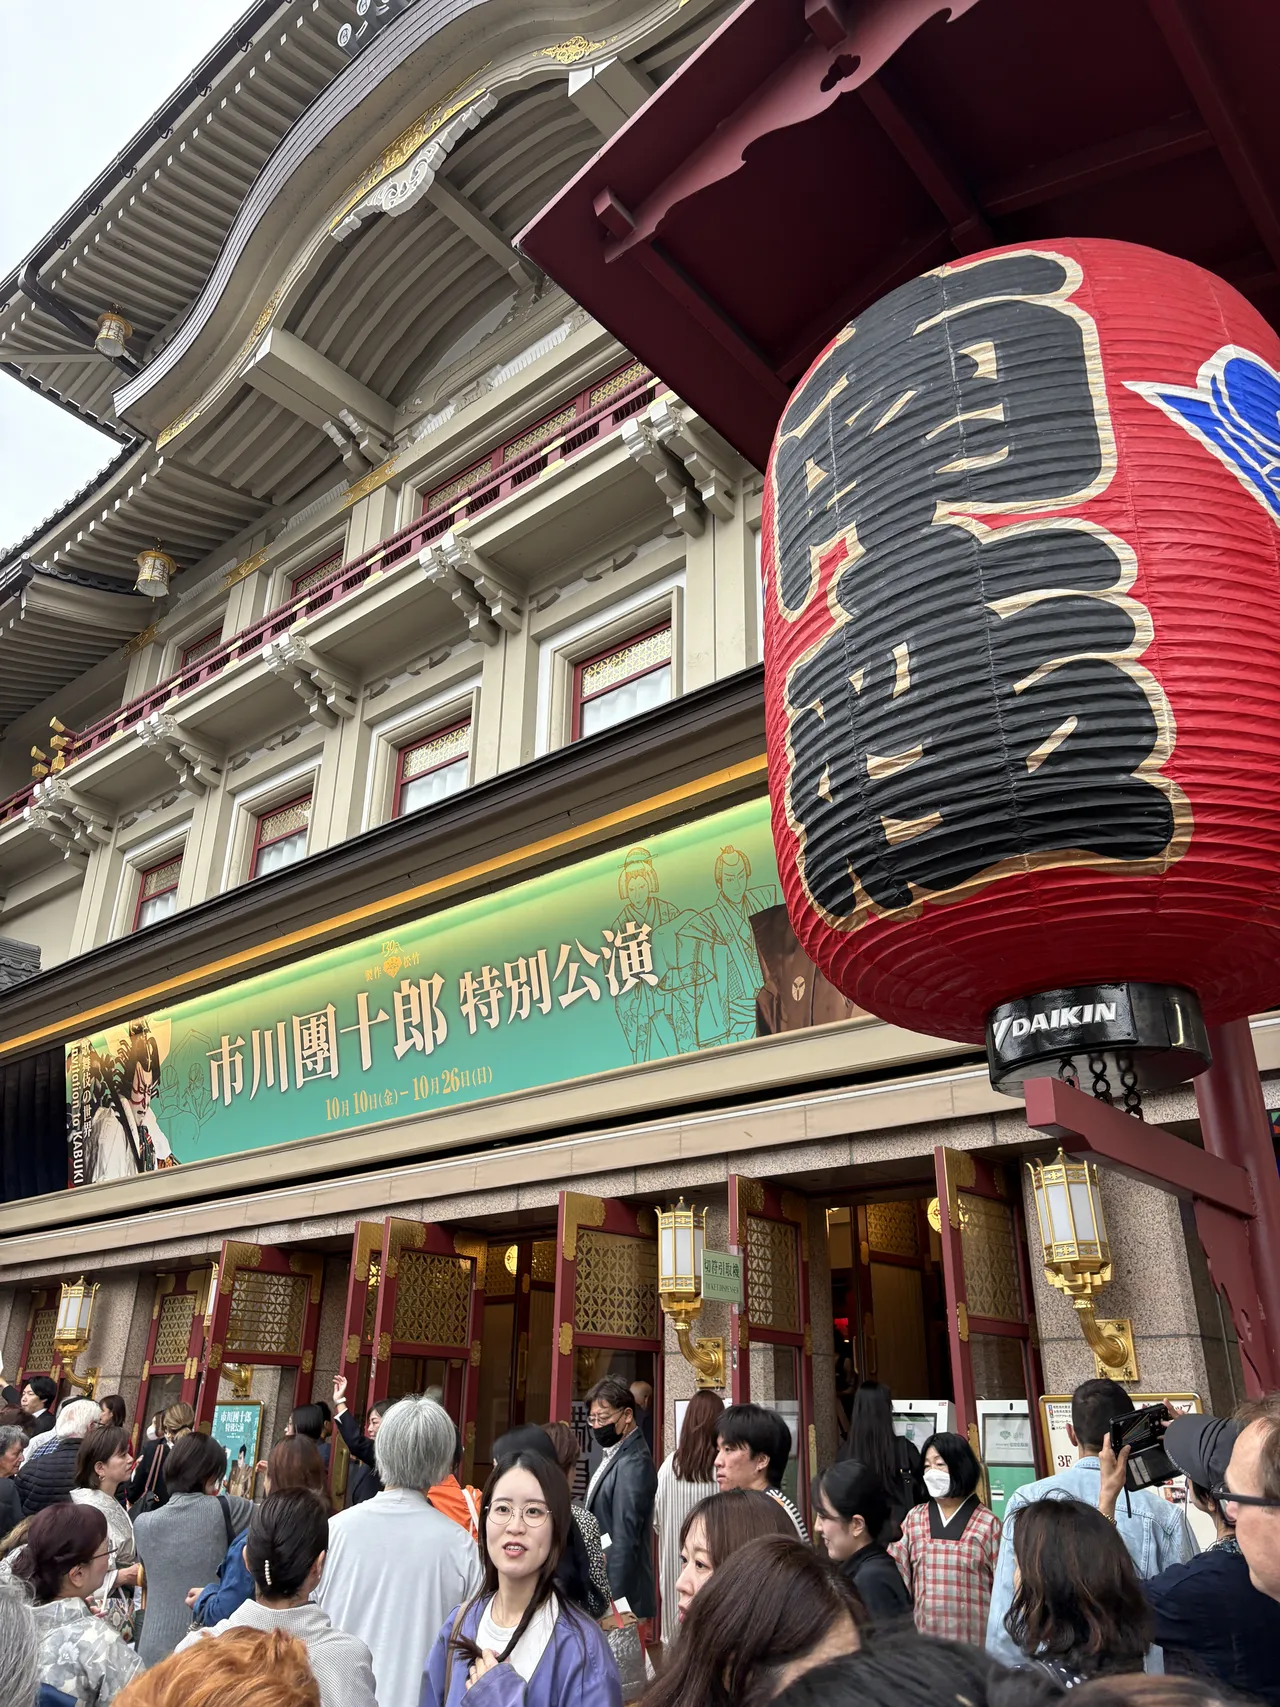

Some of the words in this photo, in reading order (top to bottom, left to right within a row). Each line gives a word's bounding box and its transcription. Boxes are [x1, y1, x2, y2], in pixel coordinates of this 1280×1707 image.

[404, 951, 420, 969] 松竹
[206, 972, 449, 1107] 市川團十郎
[459, 921, 660, 1035] 特別公演
[1012, 1002, 1117, 1038] DAIKIN
[71, 1044, 81, 1109] Invitation
[72, 1113, 81, 1127] to
[73, 1130, 84, 1184] KABUKI
[1057, 1455, 1073, 1468] 3F
